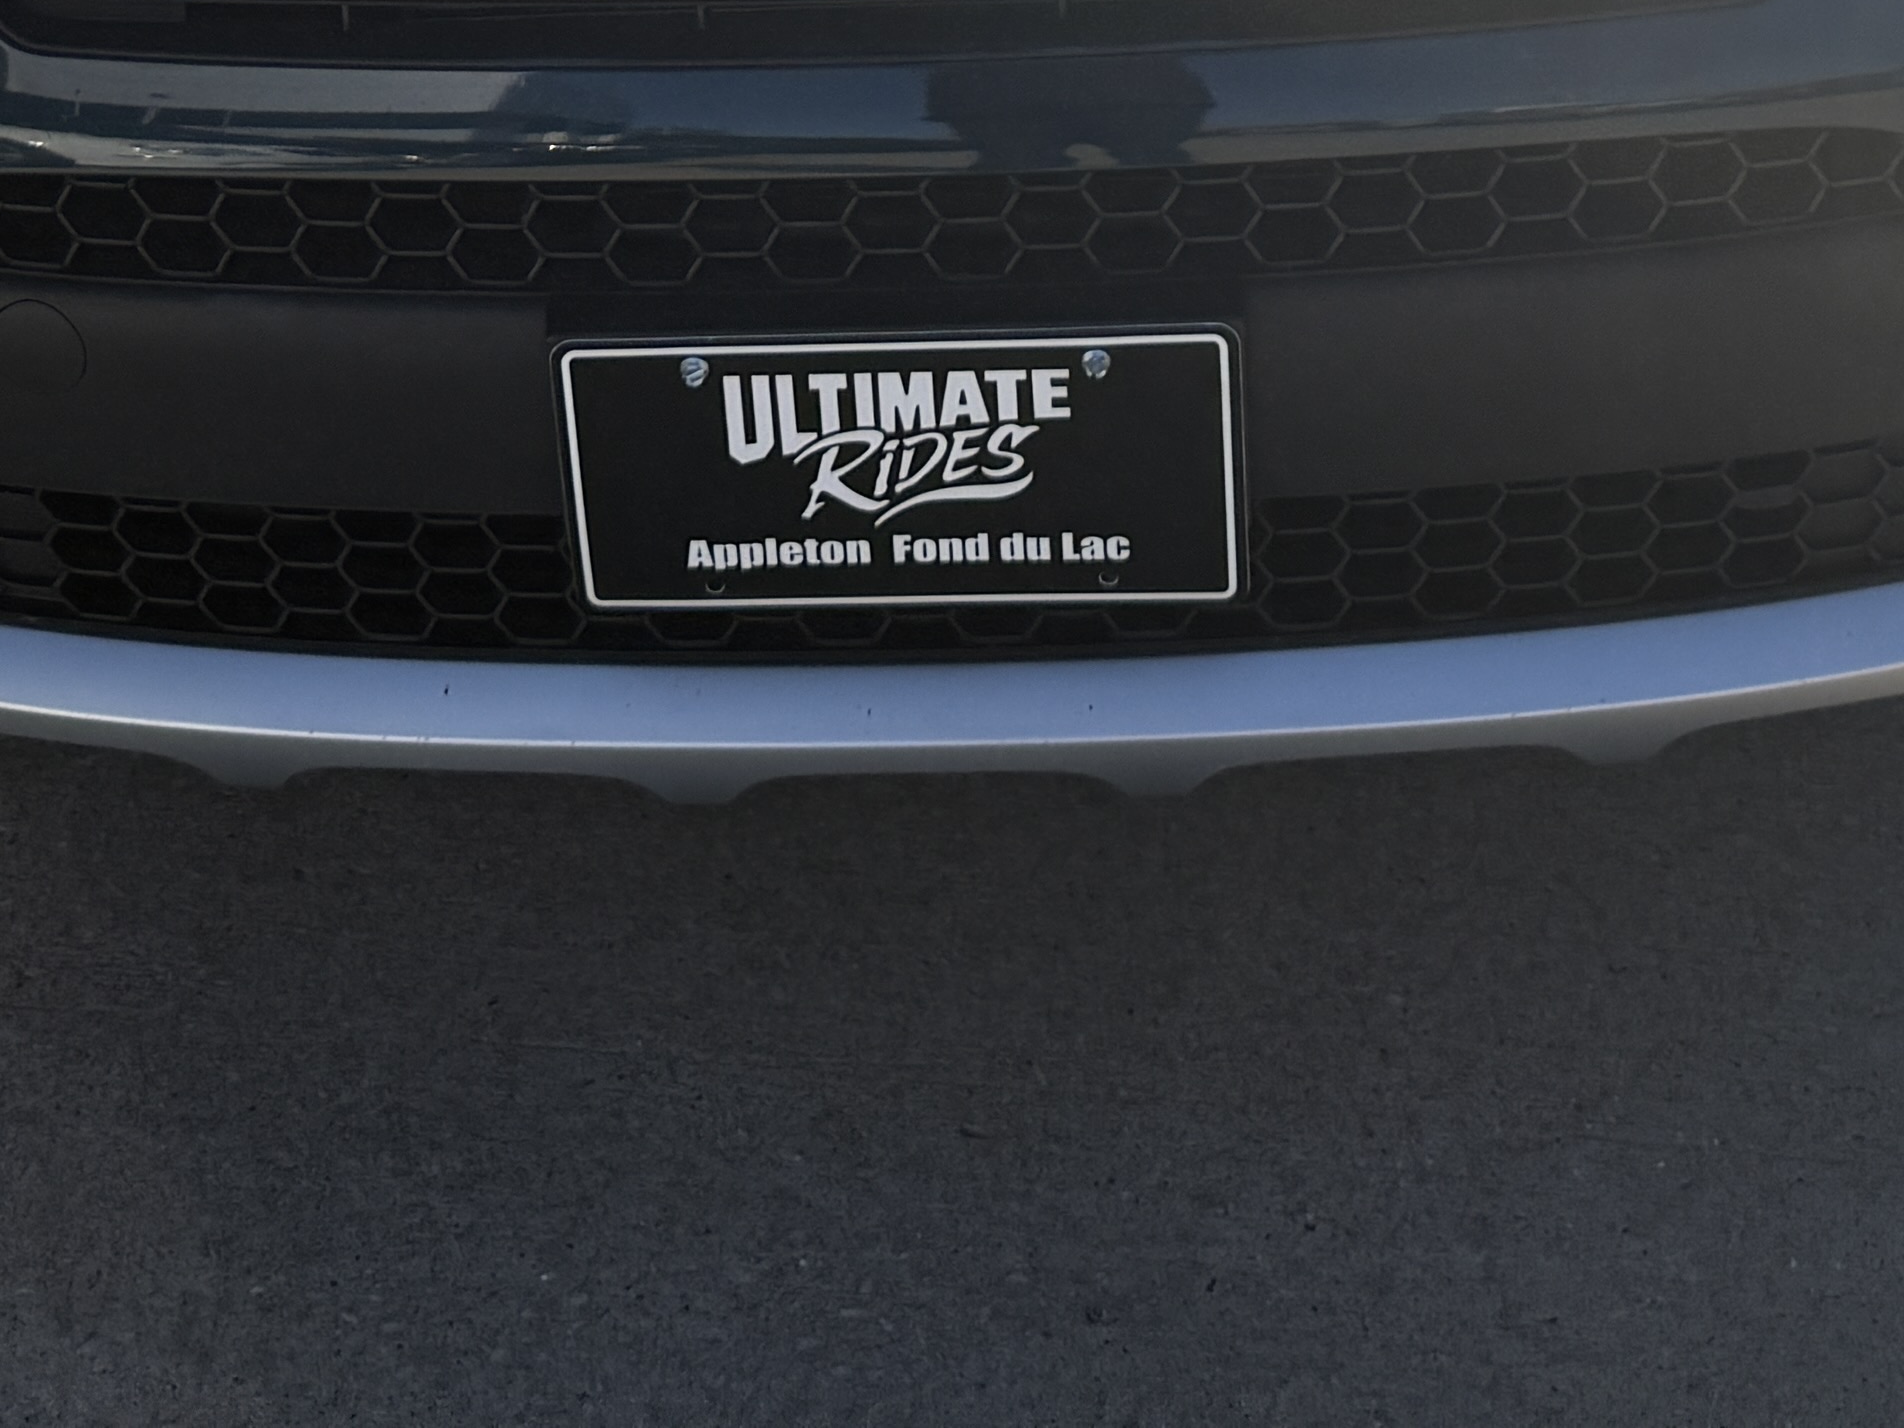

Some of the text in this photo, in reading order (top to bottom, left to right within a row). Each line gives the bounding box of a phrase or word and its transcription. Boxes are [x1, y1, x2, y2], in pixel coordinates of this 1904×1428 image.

[722, 368, 1071, 466] ULTIMATE
[686, 531, 1131, 572] Appleton Fond du Lac
